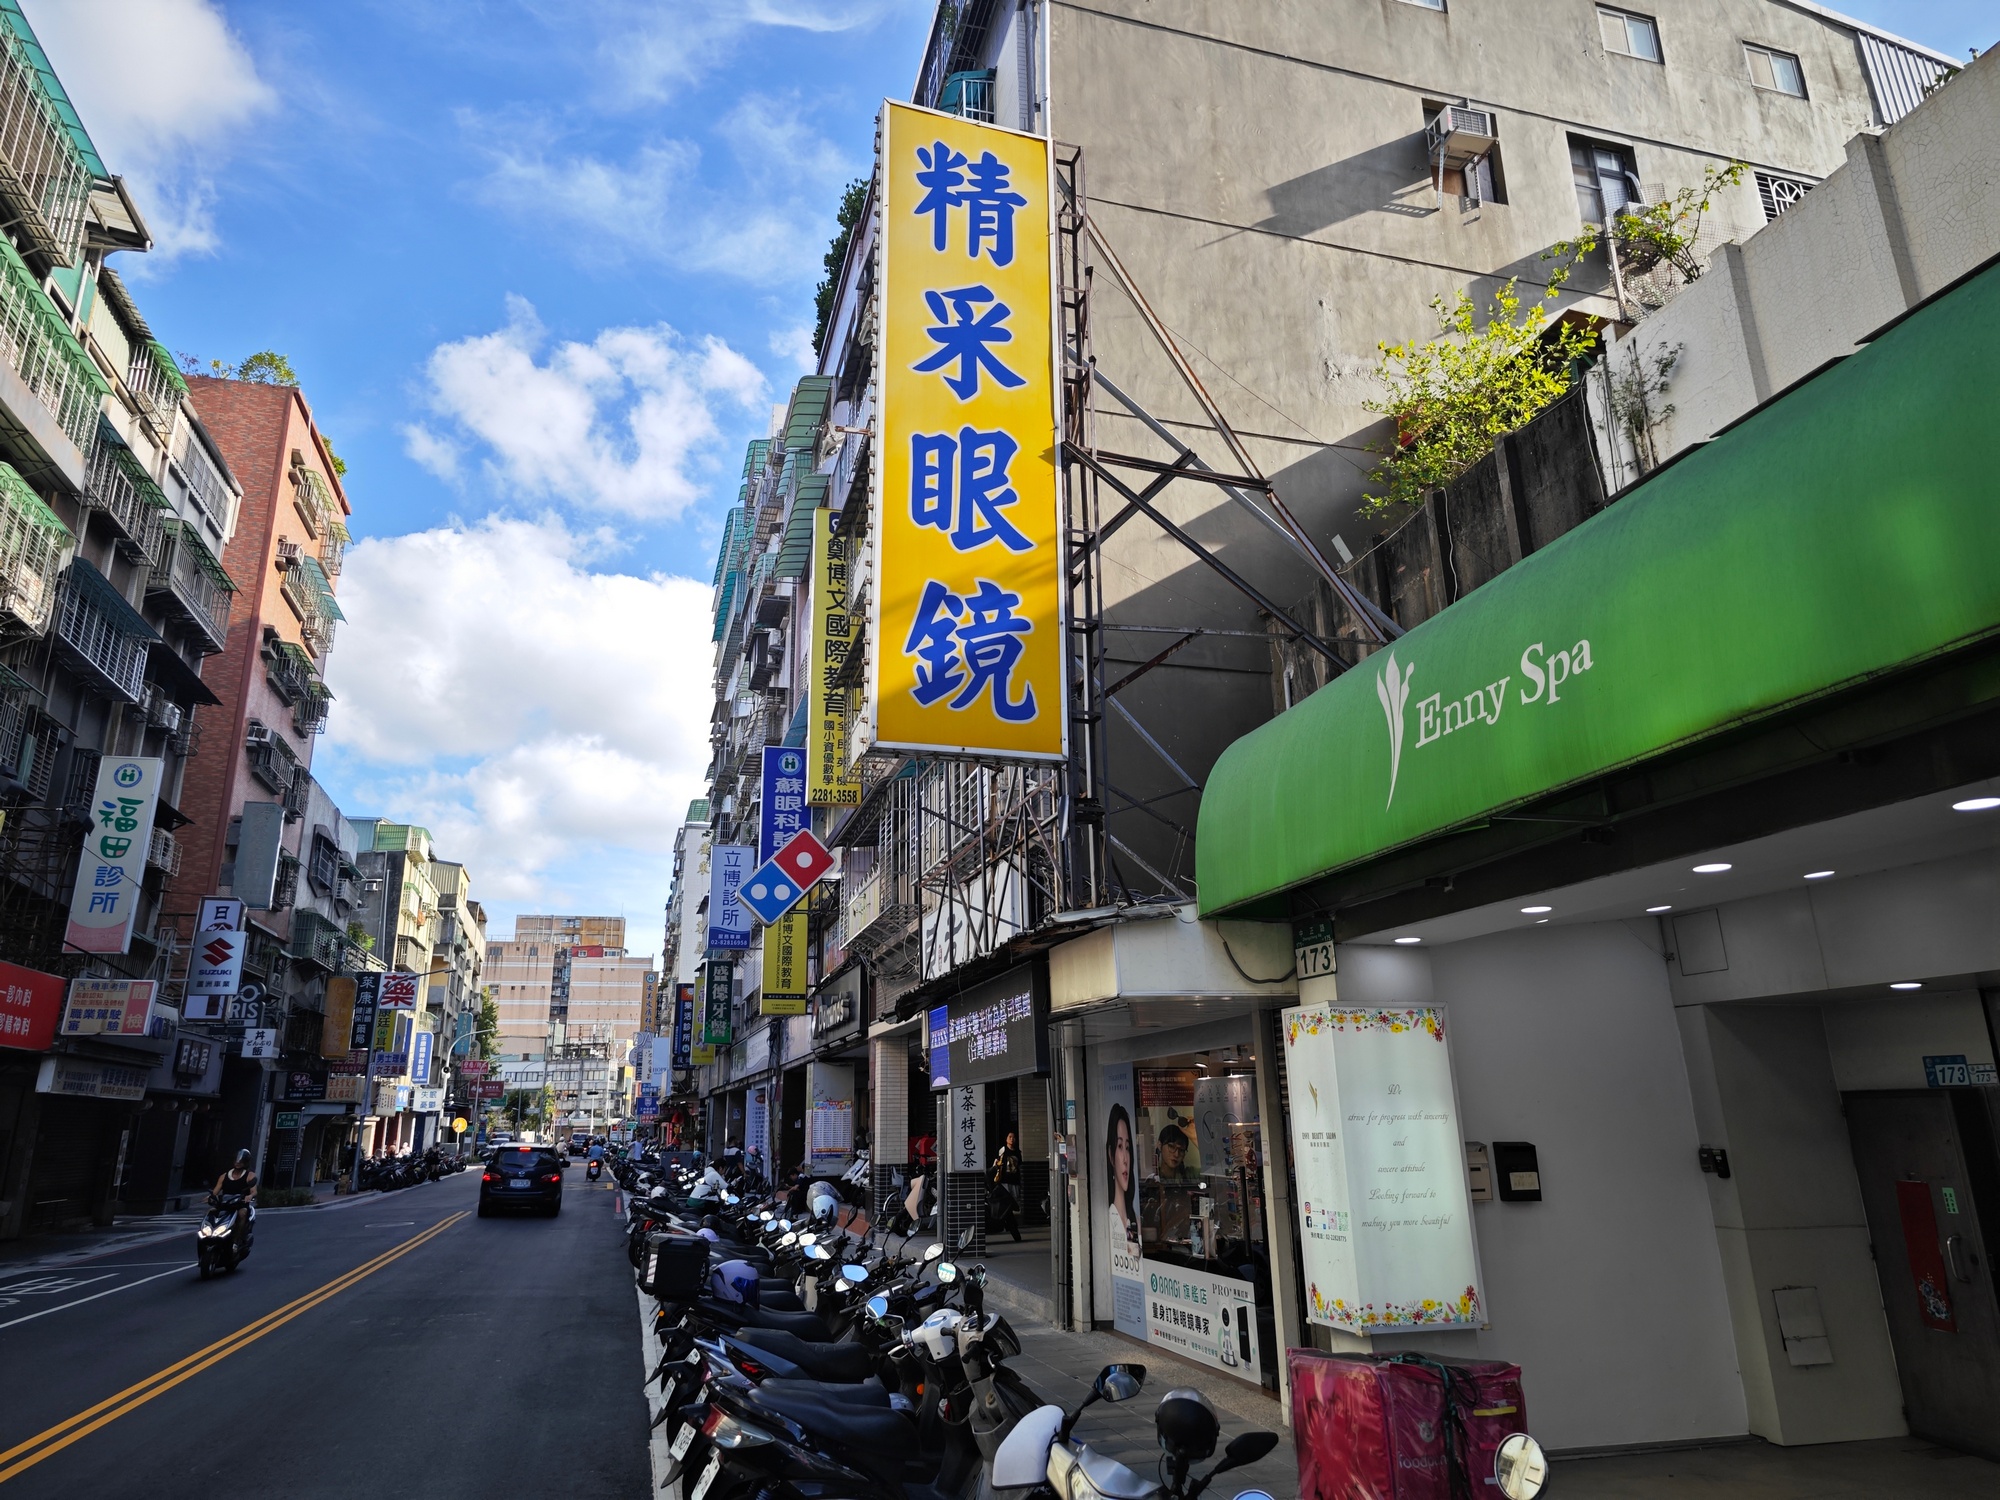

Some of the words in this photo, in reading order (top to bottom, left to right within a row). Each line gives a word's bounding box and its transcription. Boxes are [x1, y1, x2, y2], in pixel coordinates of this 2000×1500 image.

[903, 141, 1037, 725] 精采眼鏡
[1415, 676, 1510, 749] Enny
[1520, 639, 1594, 705] Spa
[812, 788, 857, 803] 2281-3558
[773, 777, 804, 856] 蘇眼科診
[88, 797, 144, 914] 福田診所
[721, 850, 741, 927] 立博診所
[1301, 946, 1330, 974] 173
[380, 974, 417, 1006] 藥
[1939, 1067, 1965, 1084] 173
[1378, 1112, 1406, 1125] progress
[1152, 1302, 1211, 1336] 量身訂製眼鏡專家
